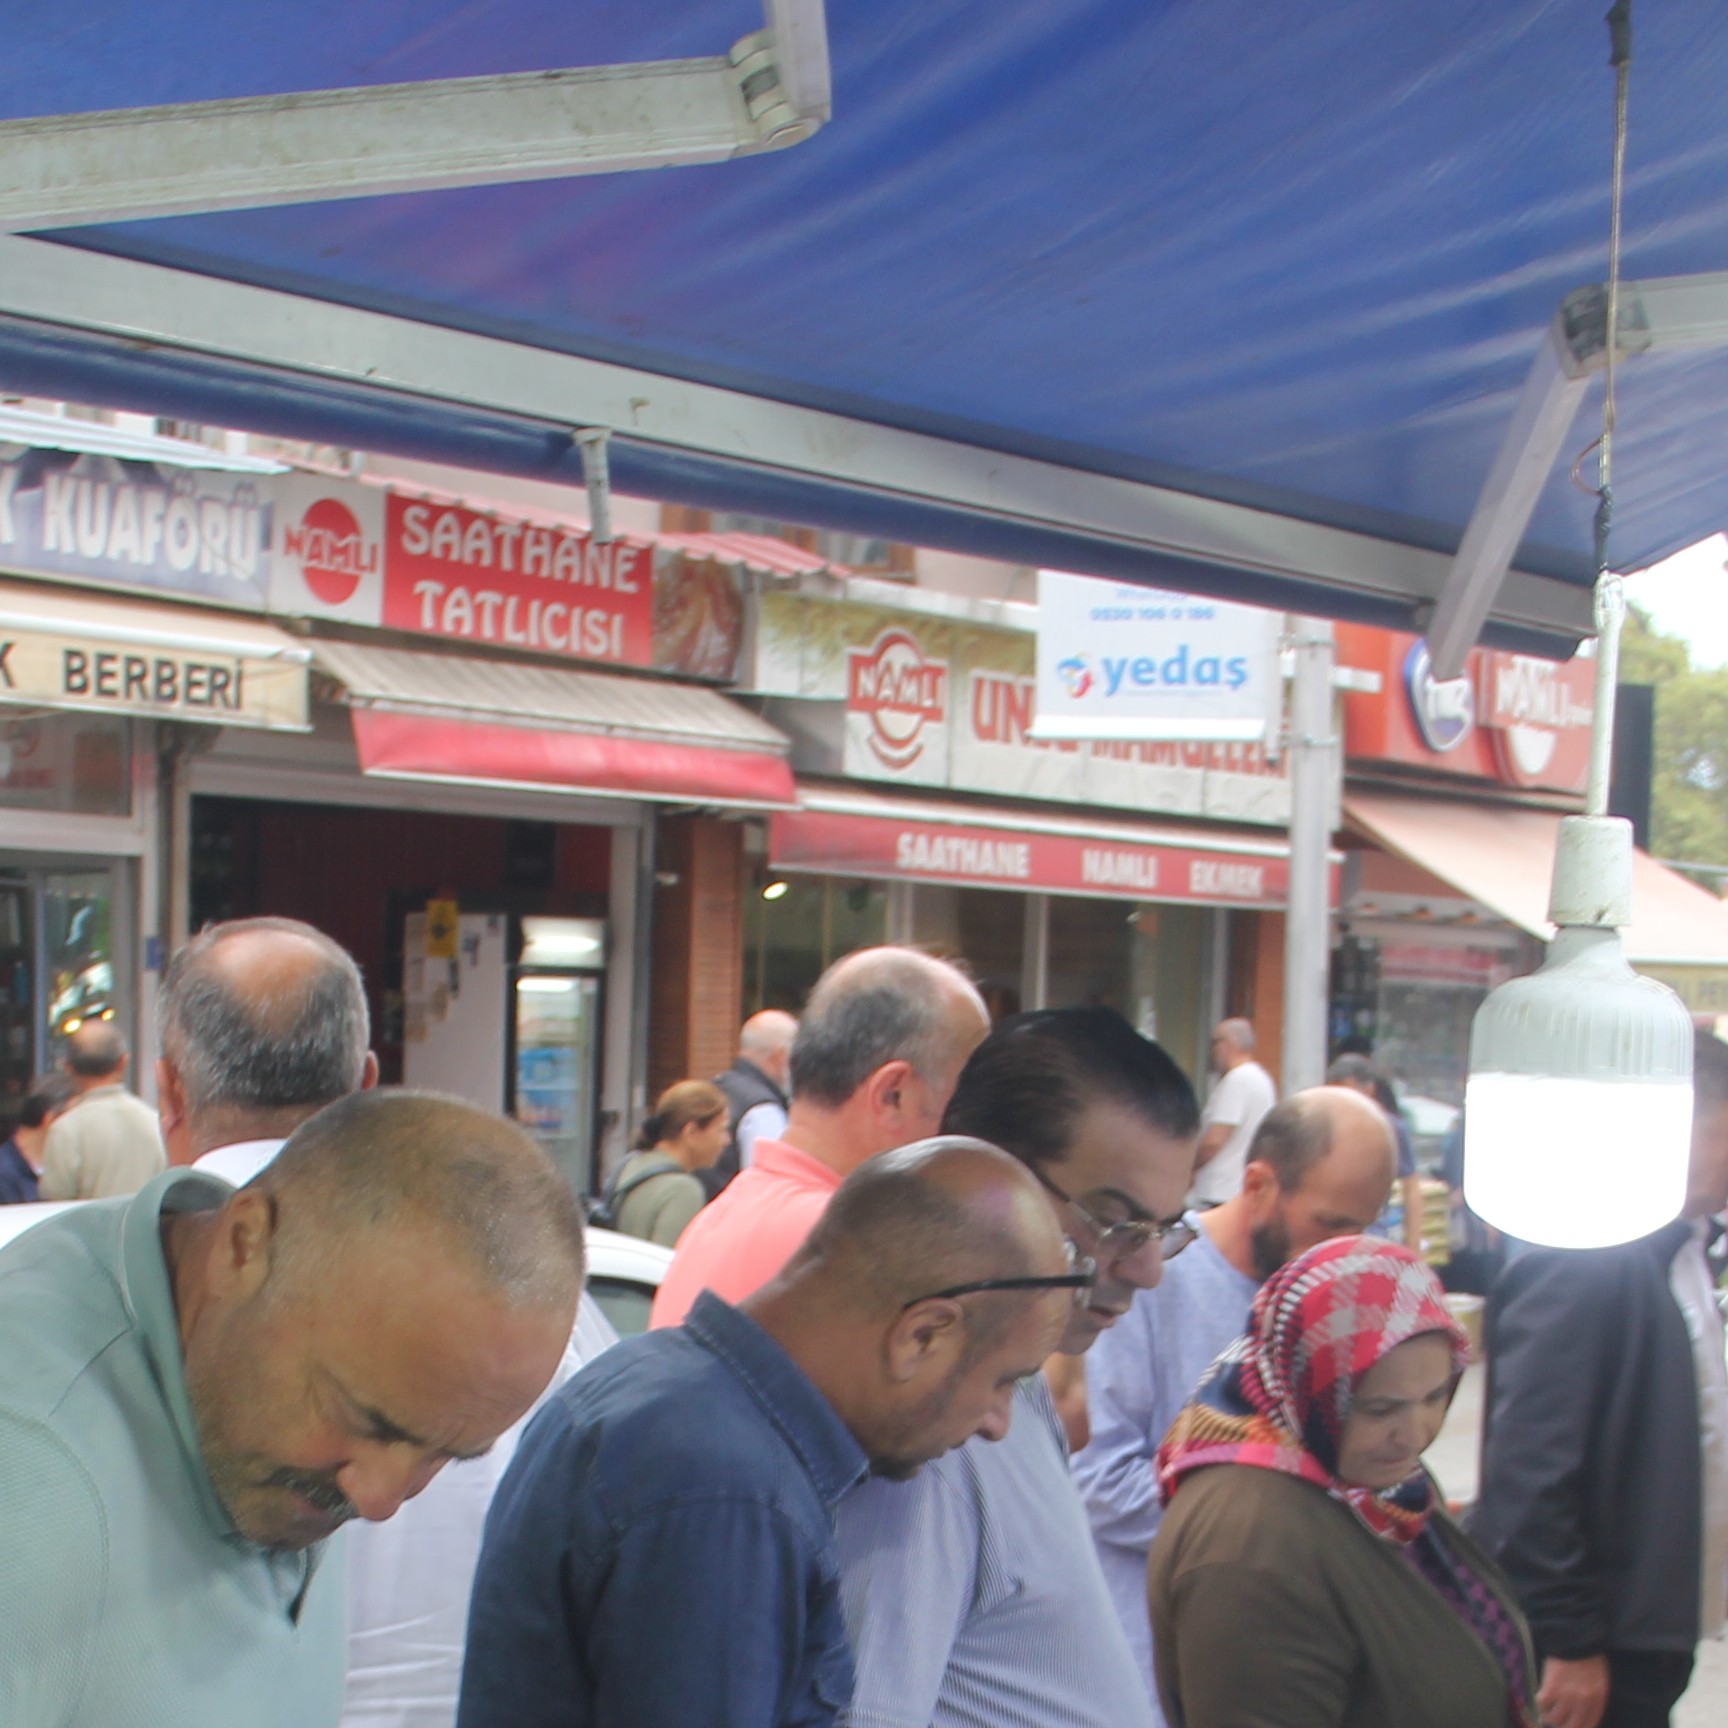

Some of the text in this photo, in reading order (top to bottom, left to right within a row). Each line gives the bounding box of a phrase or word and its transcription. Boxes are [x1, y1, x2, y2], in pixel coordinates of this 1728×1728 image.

[43, 468, 263, 580] KUAFÖRÜ
[284, 523, 378, 575] NAMLI
[401, 505, 640, 594] SAATHANE
[412, 580, 626, 660] TATLICISI
[63, 649, 244, 711] BERBERİ
[858, 660, 945, 709] NAMLI
[1101, 643, 1249, 697] yedaş
[896, 832, 1264, 898] SAATHANE NAMLI EKMEK
